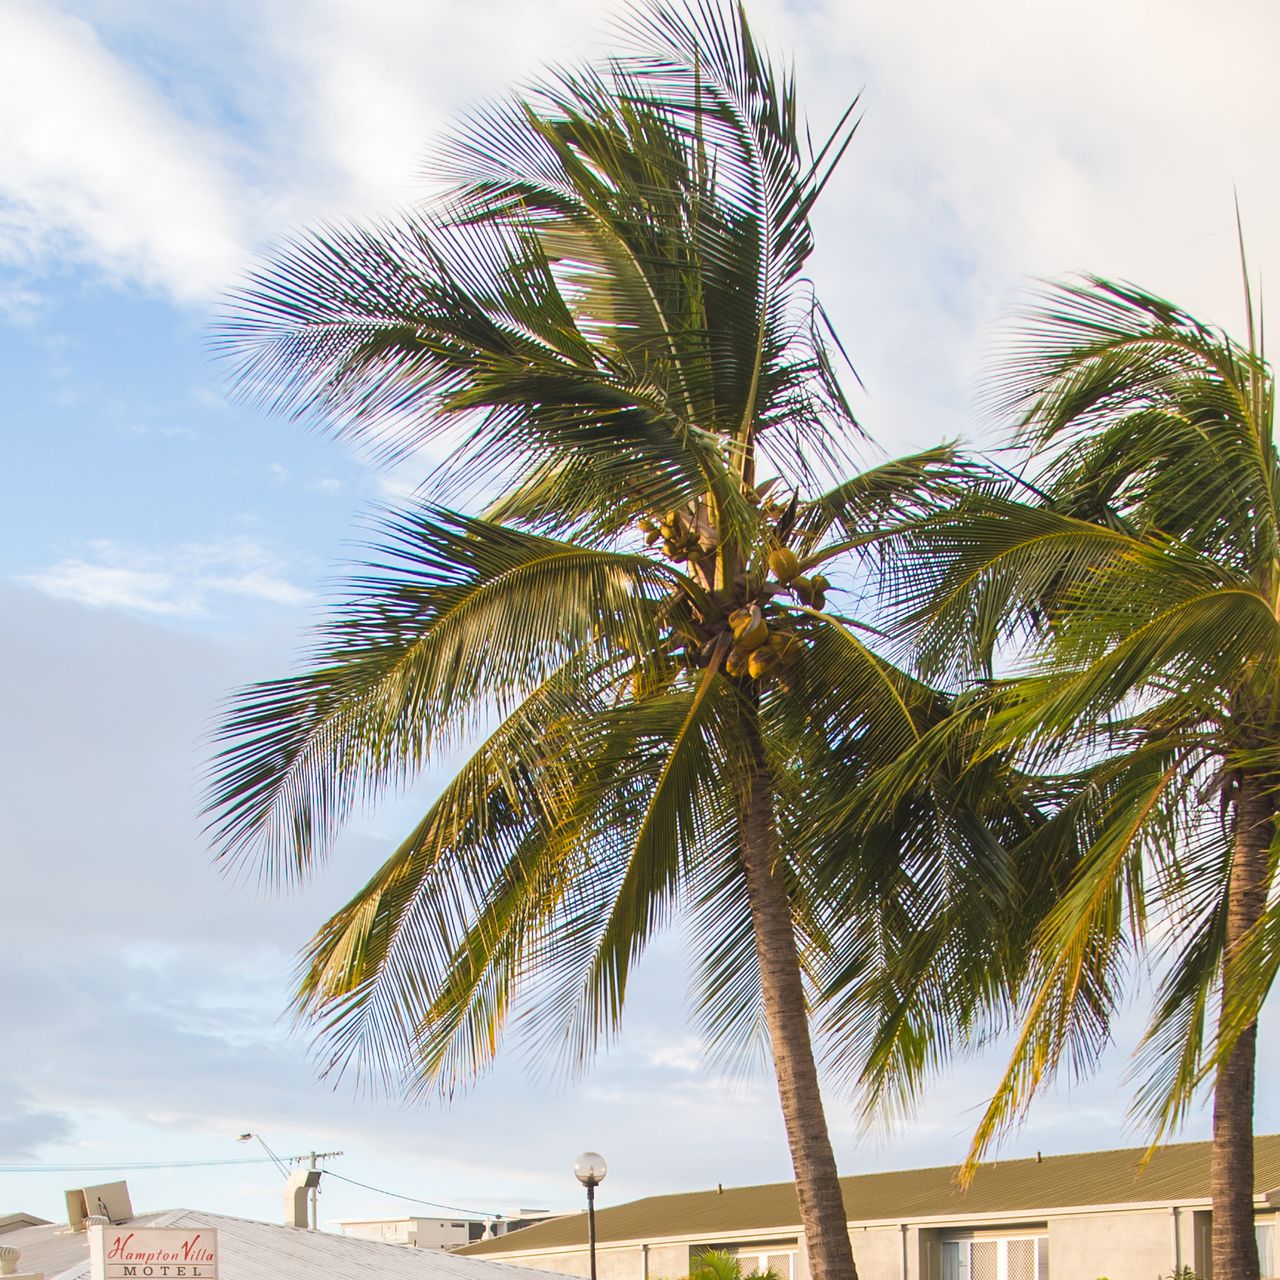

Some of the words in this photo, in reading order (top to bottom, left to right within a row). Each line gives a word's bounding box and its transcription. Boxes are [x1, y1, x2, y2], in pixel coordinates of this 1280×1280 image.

[108, 1233, 179, 1265] Hampton
[181, 1234, 214, 1261] Villa
[123, 1266, 202, 1276] MOTEL
